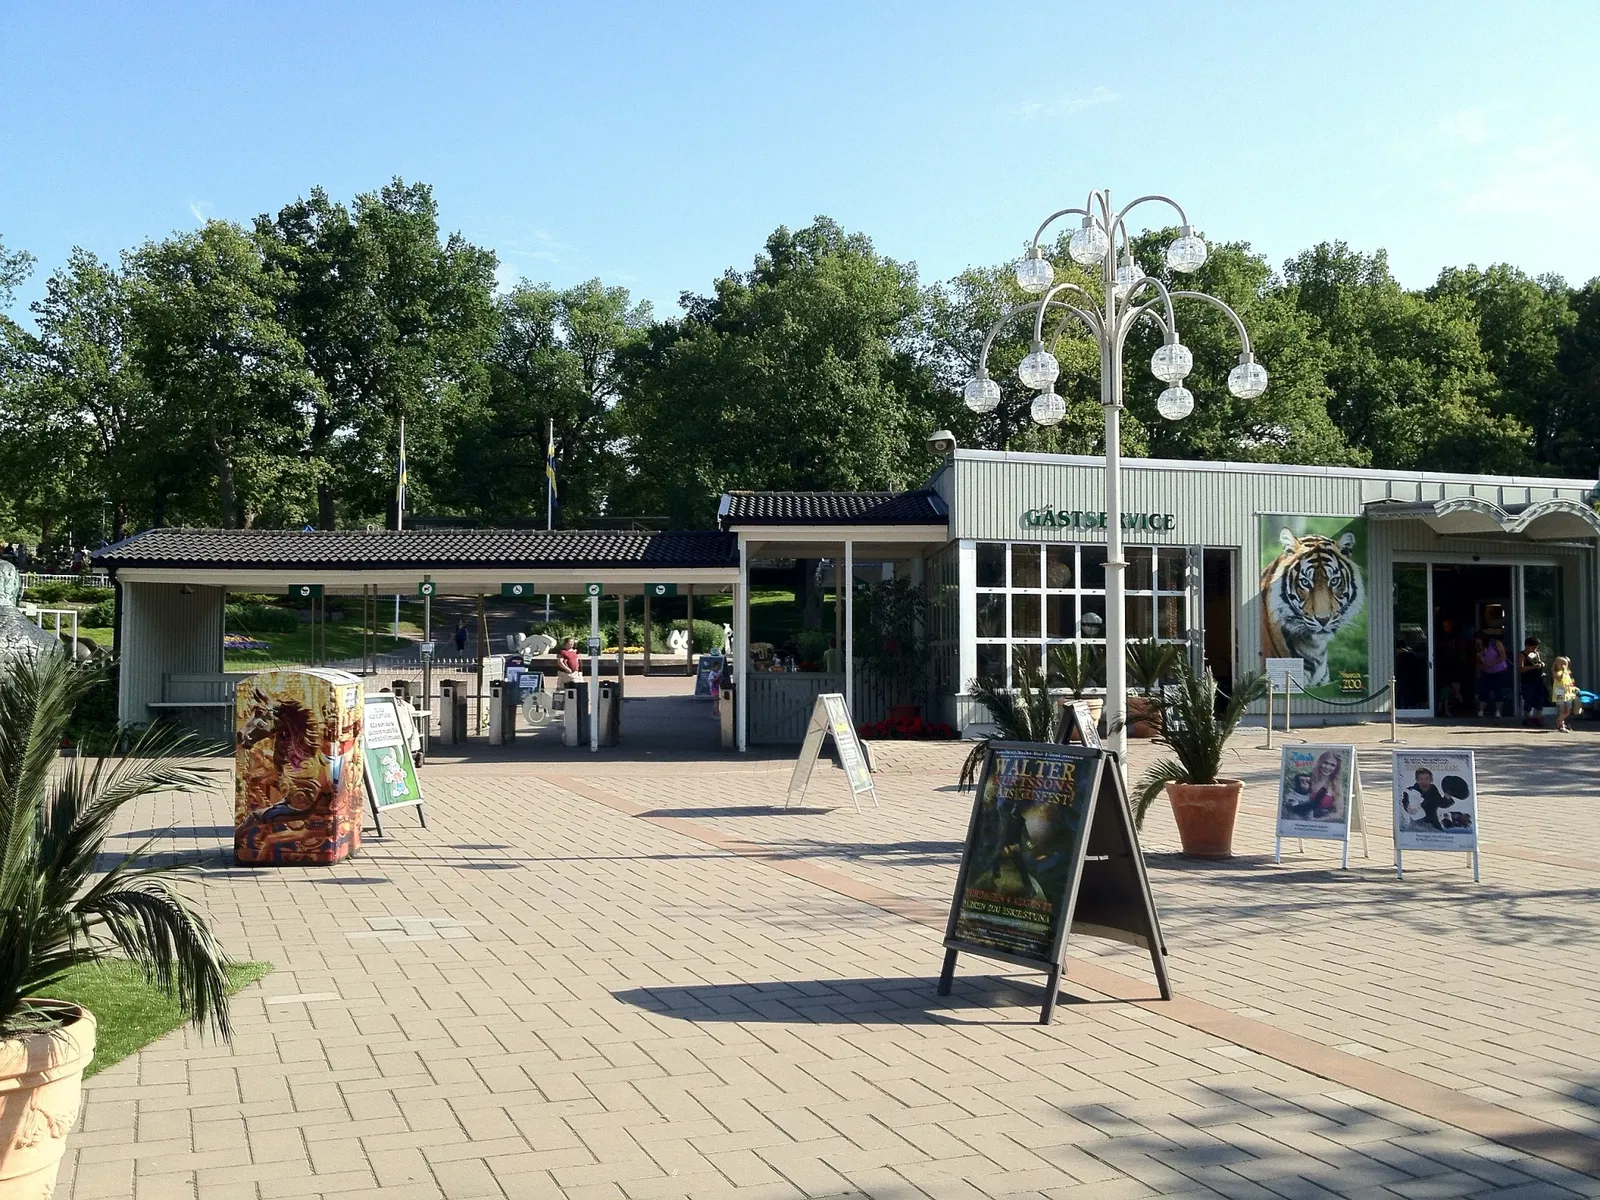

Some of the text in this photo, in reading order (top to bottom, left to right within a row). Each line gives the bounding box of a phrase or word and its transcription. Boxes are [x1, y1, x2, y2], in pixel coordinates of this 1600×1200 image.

[1342, 679, 1362, 689] ZOO
[996, 758, 1076, 781] WALTER
[993, 775, 1074, 793] KURTSSONS
